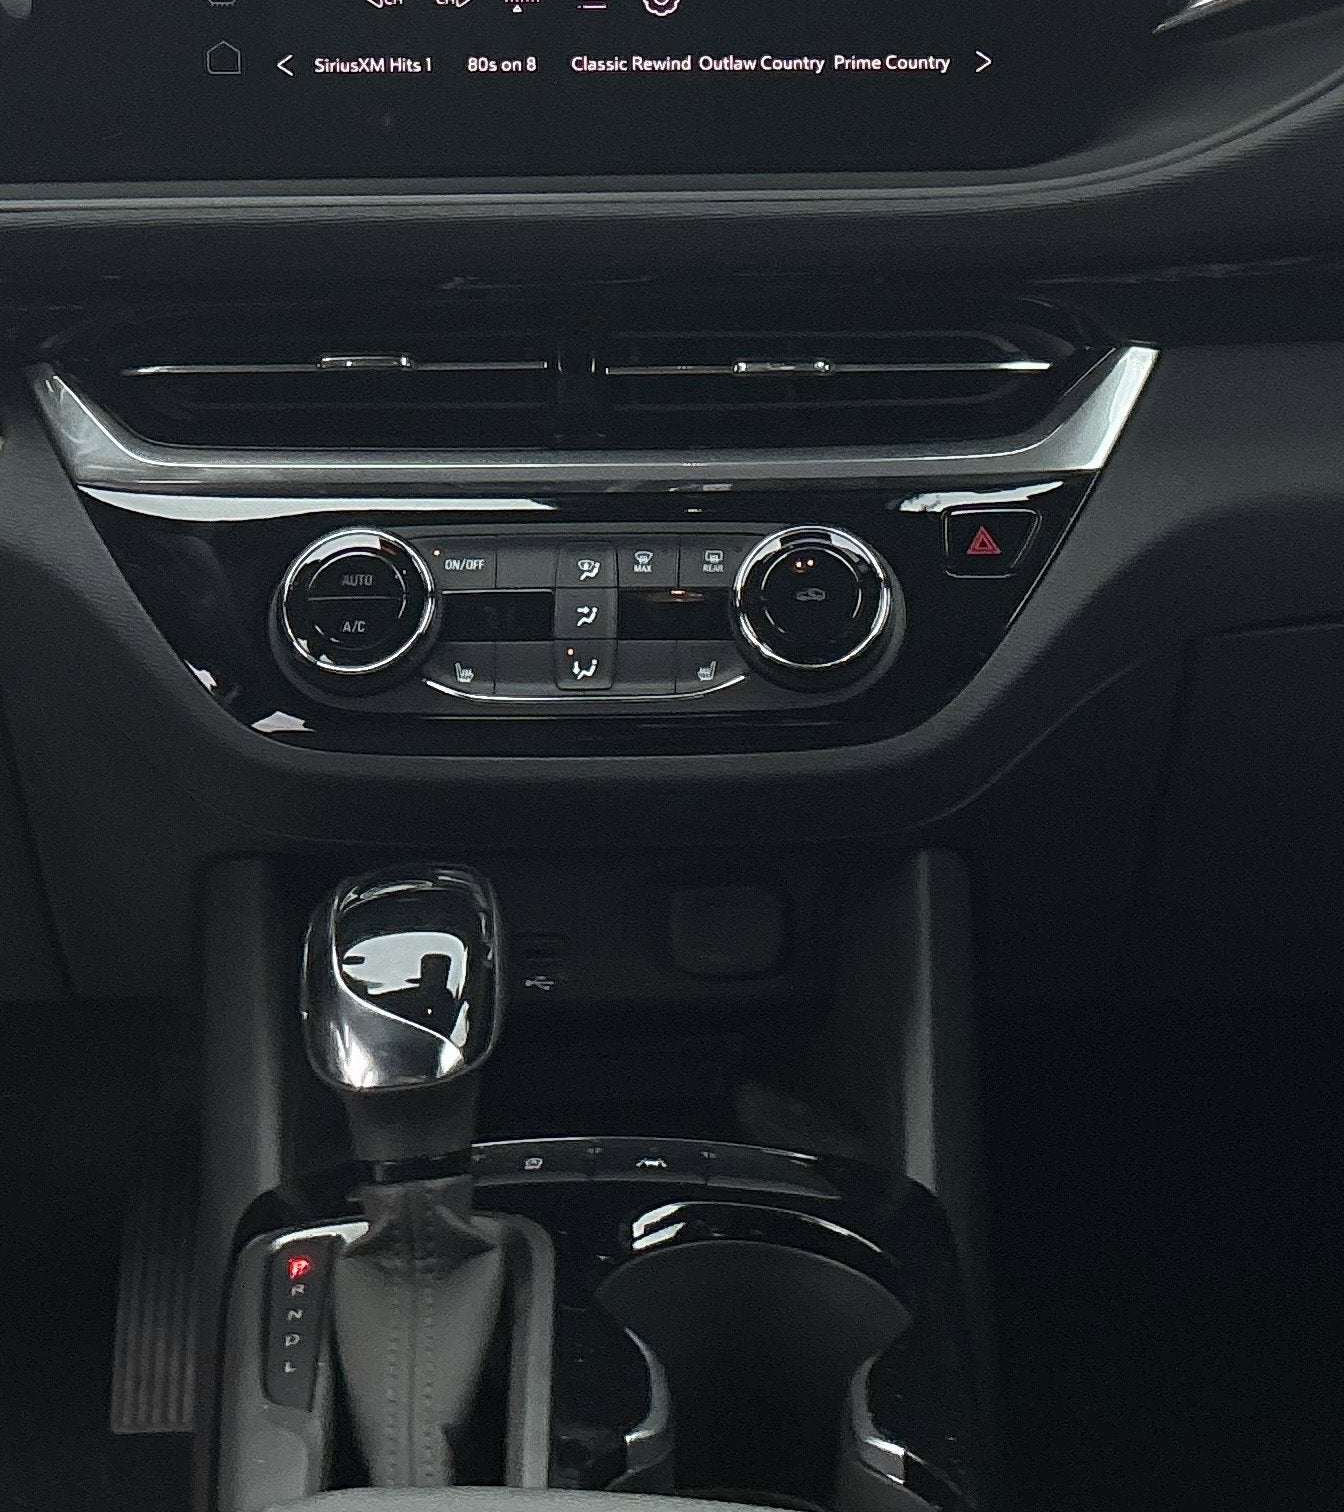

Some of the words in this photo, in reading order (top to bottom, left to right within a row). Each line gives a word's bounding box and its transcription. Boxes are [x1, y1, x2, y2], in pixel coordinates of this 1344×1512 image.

[313, 56, 387, 74] SiriusXM
[389, 56, 422, 74] Hits
[424, 56, 433, 73] 1
[466, 56, 499, 73] 80s
[499, 59, 523, 73] on
[525, 55, 538, 73] 8
[570, 54, 628, 72] Classic
[631, 54, 692, 72] Rewind
[698, 54, 758, 72] Outlaw
[759, 54, 826, 75] Country
[833, 54, 883, 71] Prime
[885, 54, 952, 75] Country
[341, 619, 367, 634] A/C
